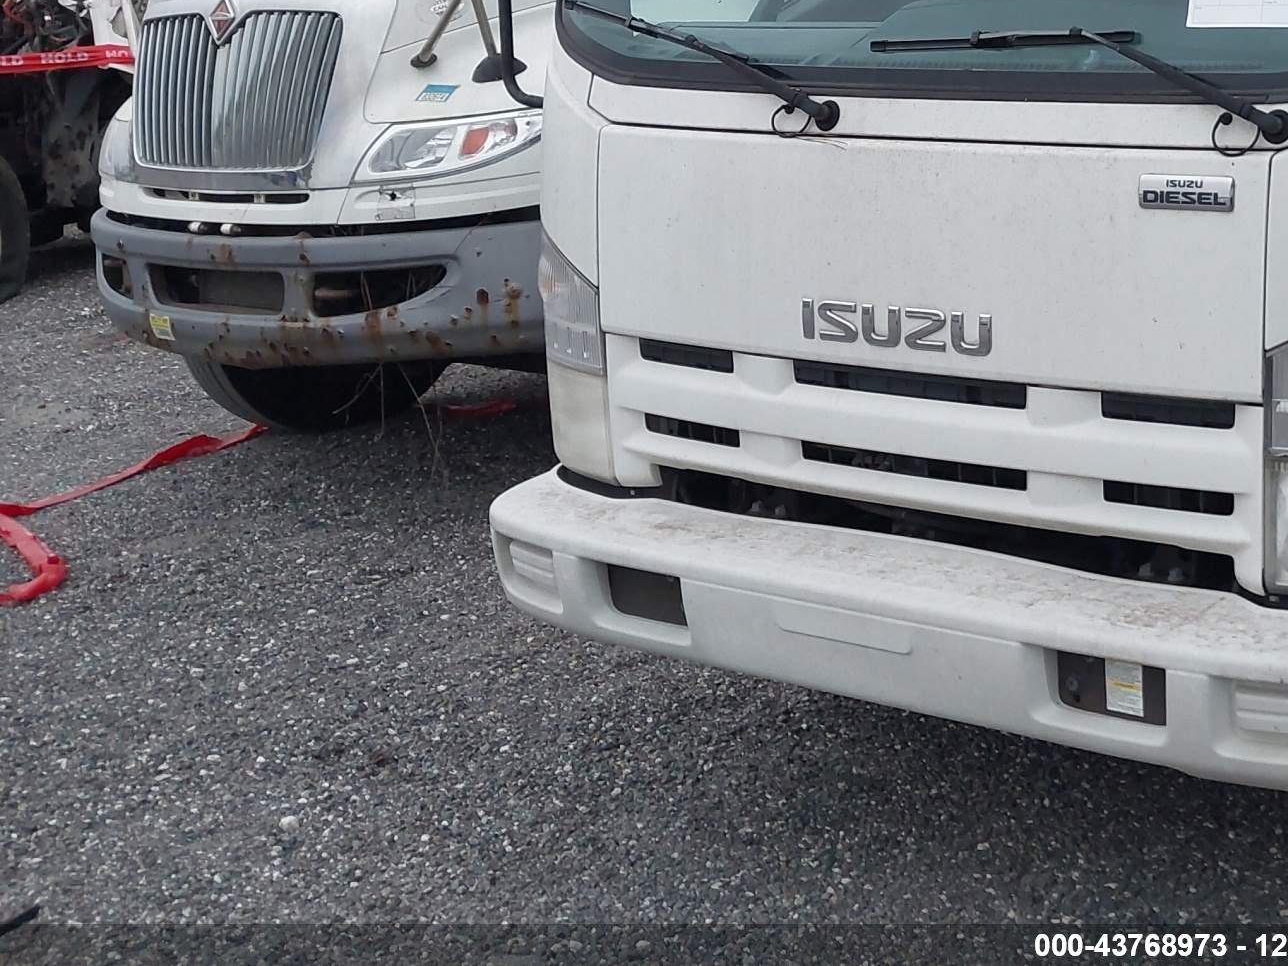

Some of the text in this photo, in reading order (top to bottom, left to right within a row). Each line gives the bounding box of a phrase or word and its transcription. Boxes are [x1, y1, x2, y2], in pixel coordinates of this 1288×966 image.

[0, 55, 24, 66] LD
[41, 52, 88, 64] HOLD
[1166, 179, 1203, 189] ISUZU
[1143, 190, 1227, 206] DIESEL
[802, 298, 992, 356] ISUZU
